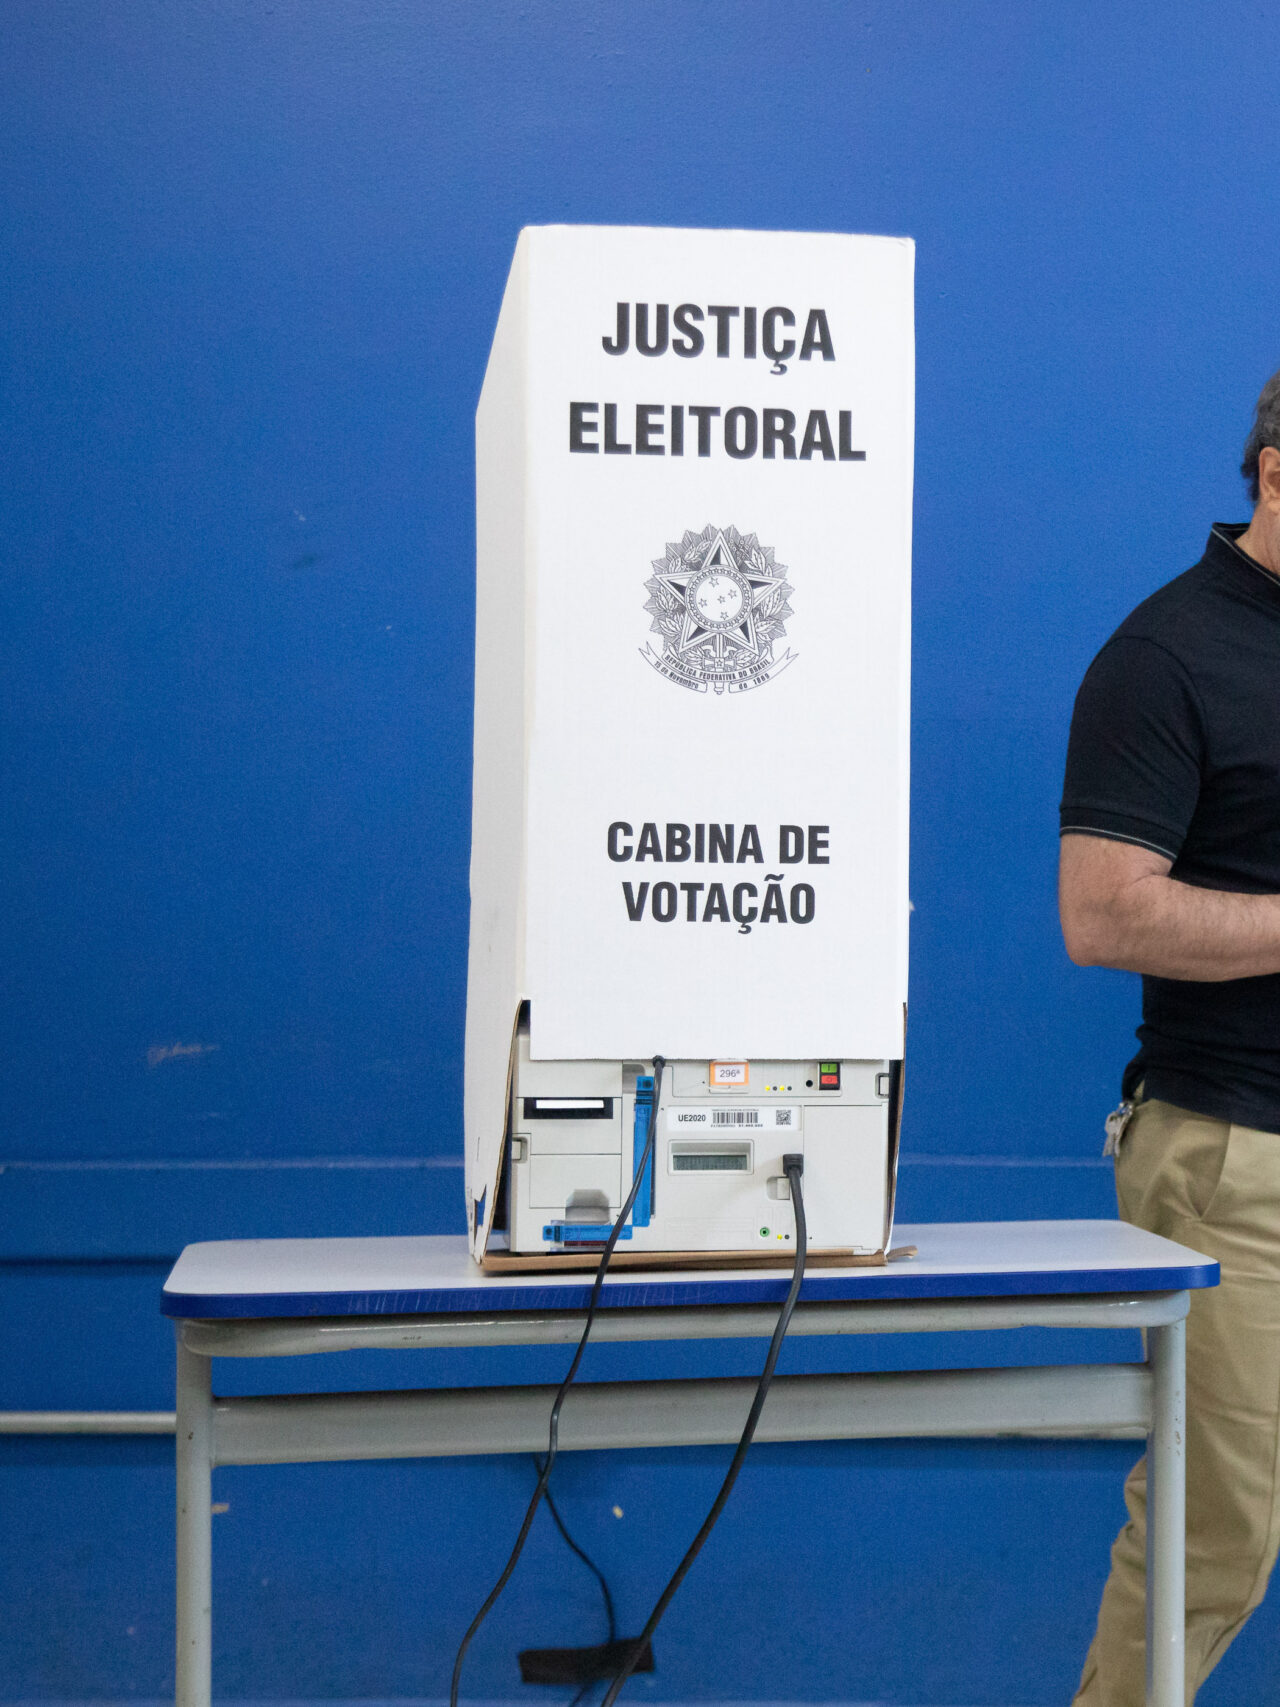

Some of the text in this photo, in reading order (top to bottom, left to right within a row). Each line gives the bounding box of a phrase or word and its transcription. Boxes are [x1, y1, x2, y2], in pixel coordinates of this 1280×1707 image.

[602, 303, 834, 374] JUSTIÇA
[570, 402, 865, 460] ELEITORAL
[668, 671, 699, 689] Novembro
[753, 673, 770, 685] 1889
[699, 671, 736, 681] FEDERATIVA
[749, 659, 770, 674] BRASIL
[608, 822, 829, 864] CABINA DE
[622, 874, 815, 934] VOTAÇÃO
[678, 1114, 706, 1122] UE2020
